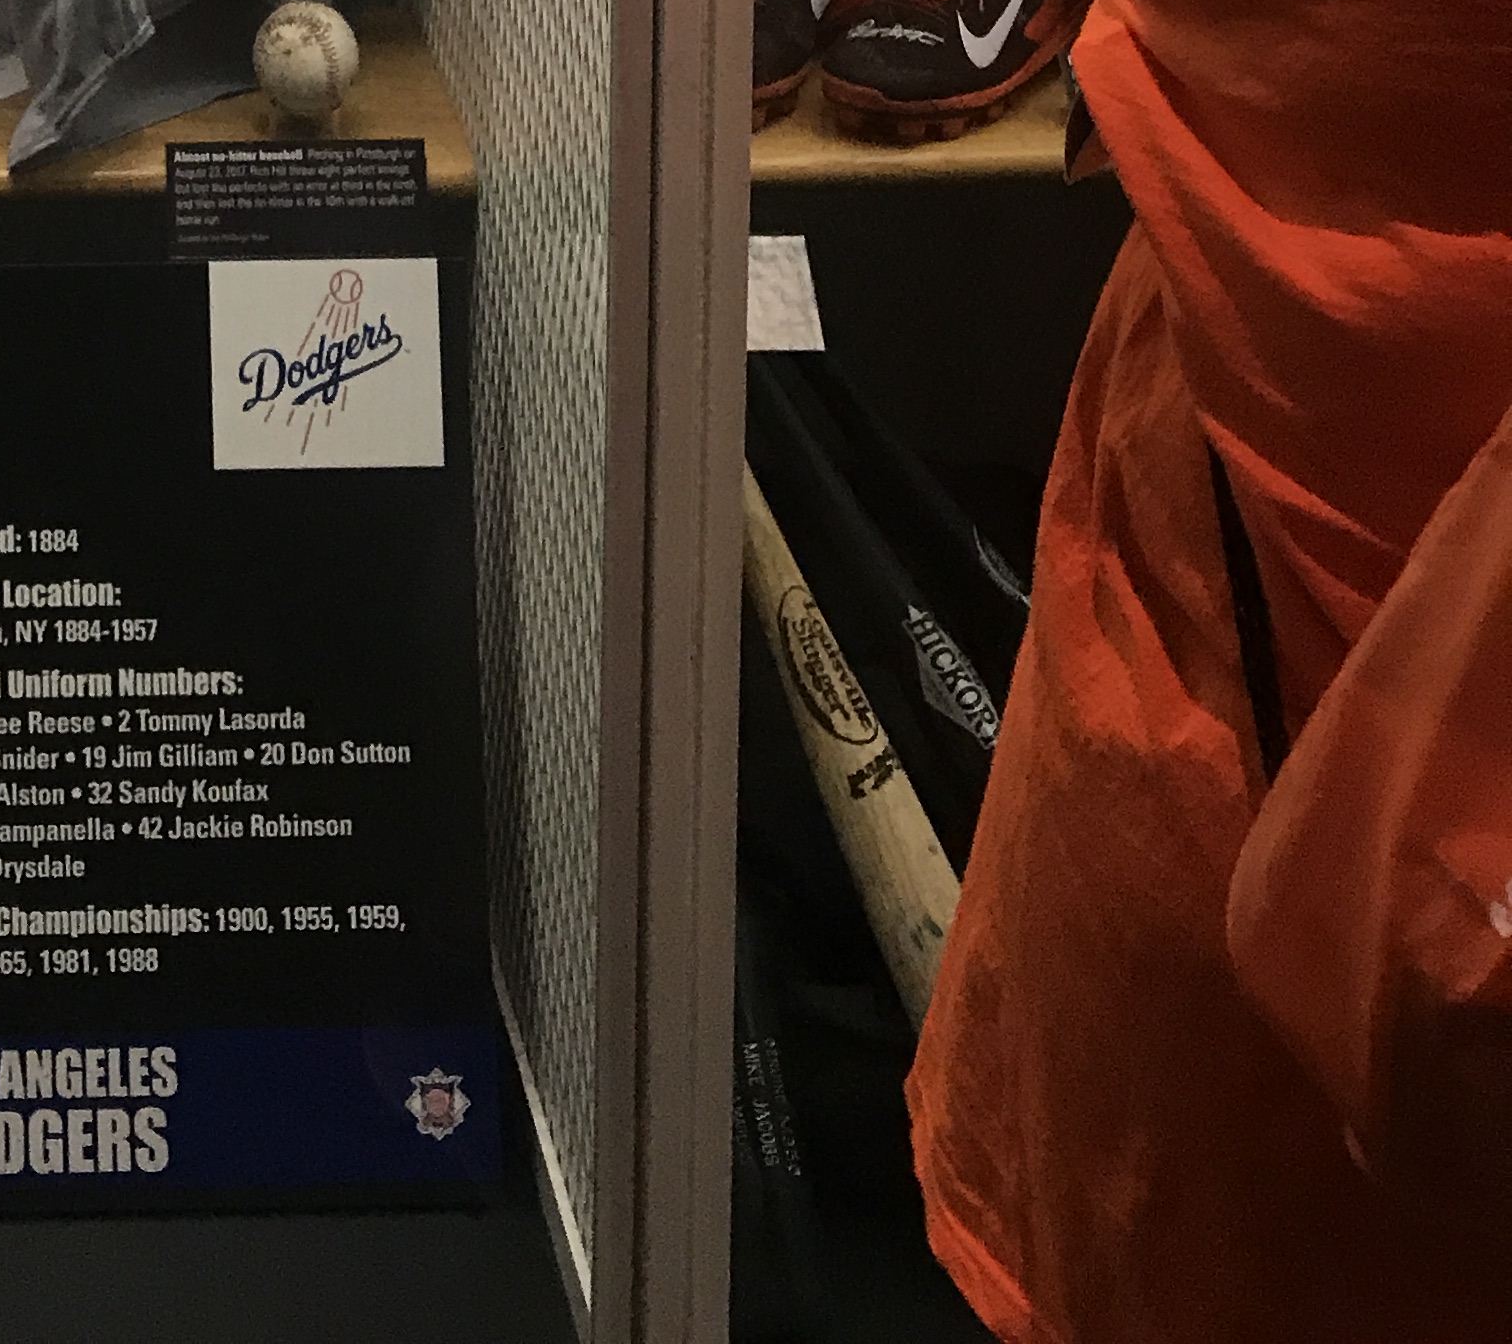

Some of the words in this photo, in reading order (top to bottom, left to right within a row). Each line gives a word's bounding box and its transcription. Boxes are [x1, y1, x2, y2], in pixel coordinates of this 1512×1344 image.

[238, 312, 403, 412] Dodgers
[30, 529, 78, 552] 1884
[3, 579, 121, 607] Location:
[16, 620, 47, 642] NY
[55, 619, 157, 642] 1884-1957
[791, 615, 851, 722] Slugger
[8, 670, 112, 698] Uniform
[119, 668, 243, 696] Numbers:
[29, 711, 95, 733] Reese
[119, 709, 130, 732] 2
[136, 709, 212, 735] Tommy
[219, 707, 305, 730] Lasorda
[83, 746, 106, 768] 19
[112, 745, 151, 768] Jim
[159, 744, 237, 767] Gilliam
[261, 743, 285, 765] 20
[292, 742, 333, 764] Don
[341, 741, 410, 763] Sutton
[88, 782, 112, 804] 32
[119, 780, 186, 807] Sandy
[193, 779, 268, 802] Koufax
[139, 816, 162, 839] 42
[168, 815, 243, 839] Jackie
[251, 814, 352, 837] Robinson
[216, 907, 274, 933] 1900,
[282, 907, 339, 932] 1955,
[348, 905, 405, 931] 1959,
[40, 949, 98, 975] 1981,
[107, 948, 158, 972] 1988
